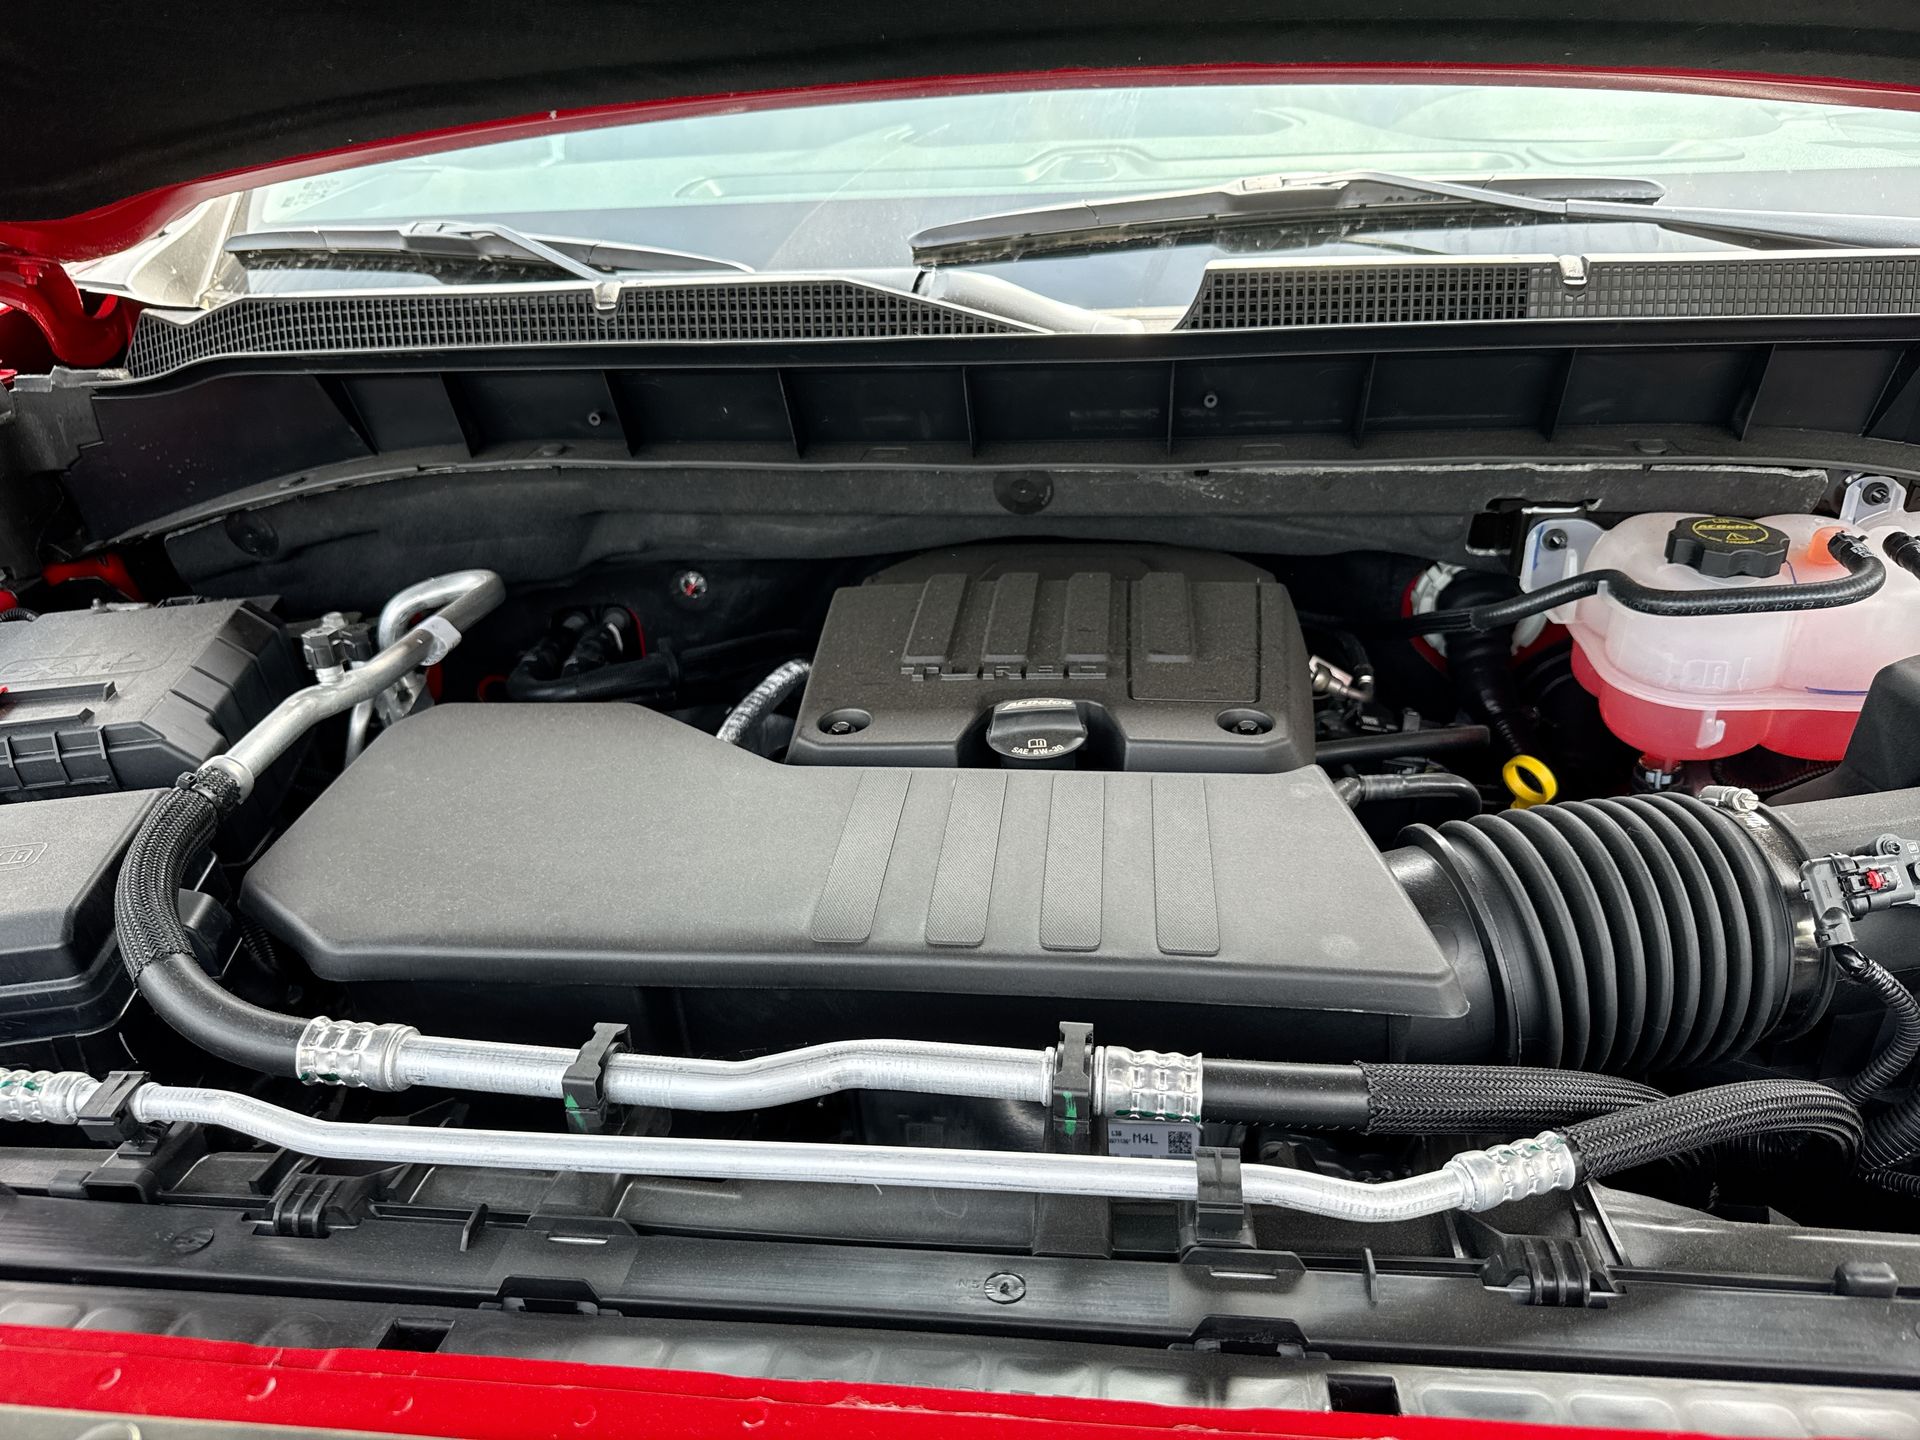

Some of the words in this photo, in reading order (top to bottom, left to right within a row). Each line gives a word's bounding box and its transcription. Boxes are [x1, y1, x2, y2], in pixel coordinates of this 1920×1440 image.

[1011, 746, 1029, 755] SAE
[1033, 744, 1065, 755] 5W-30
[1132, 1133, 1158, 1144] M4L
